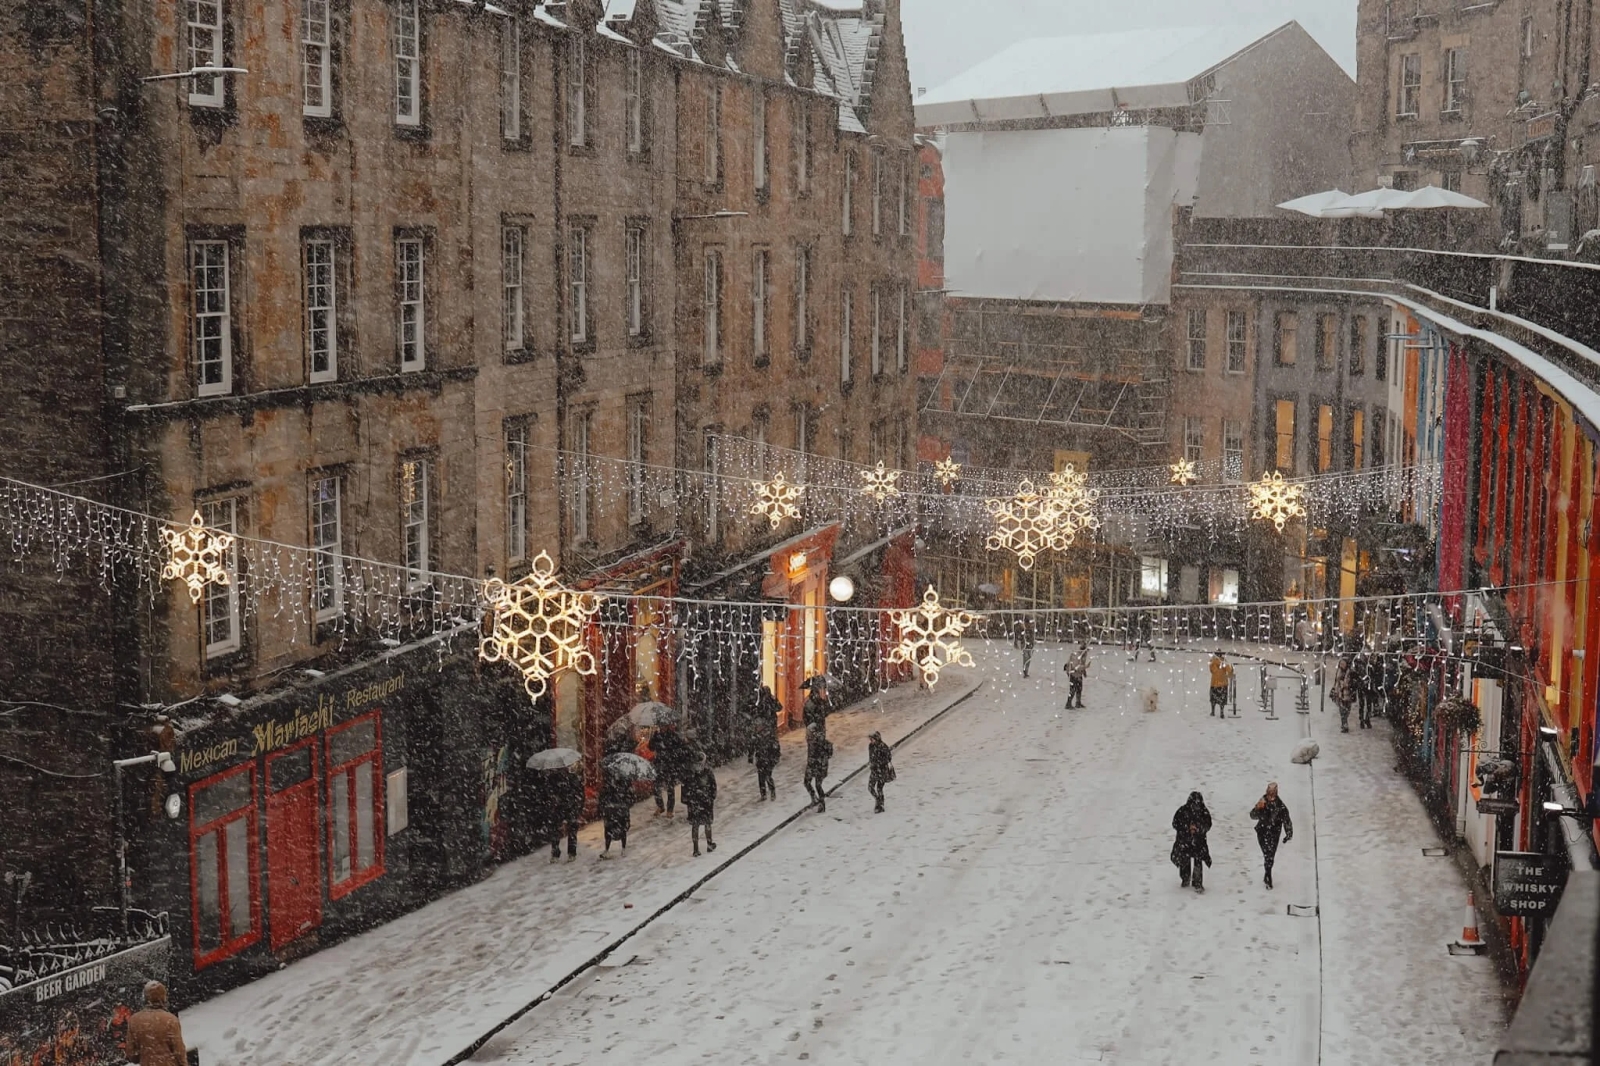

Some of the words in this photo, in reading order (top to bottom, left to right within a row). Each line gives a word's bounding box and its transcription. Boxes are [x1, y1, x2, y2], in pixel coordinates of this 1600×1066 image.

[180, 738, 237, 773] Mexican
[251, 693, 334, 756] Mariachi
[346, 672, 405, 709] Restaurant
[1516, 866, 1545, 876] THE
[1502, 883, 1557, 894] WHISKY
[1510, 900, 1546, 910] SHOP
[36, 981, 62, 1002] BEER
[65, 964, 106, 992] GARDEN
